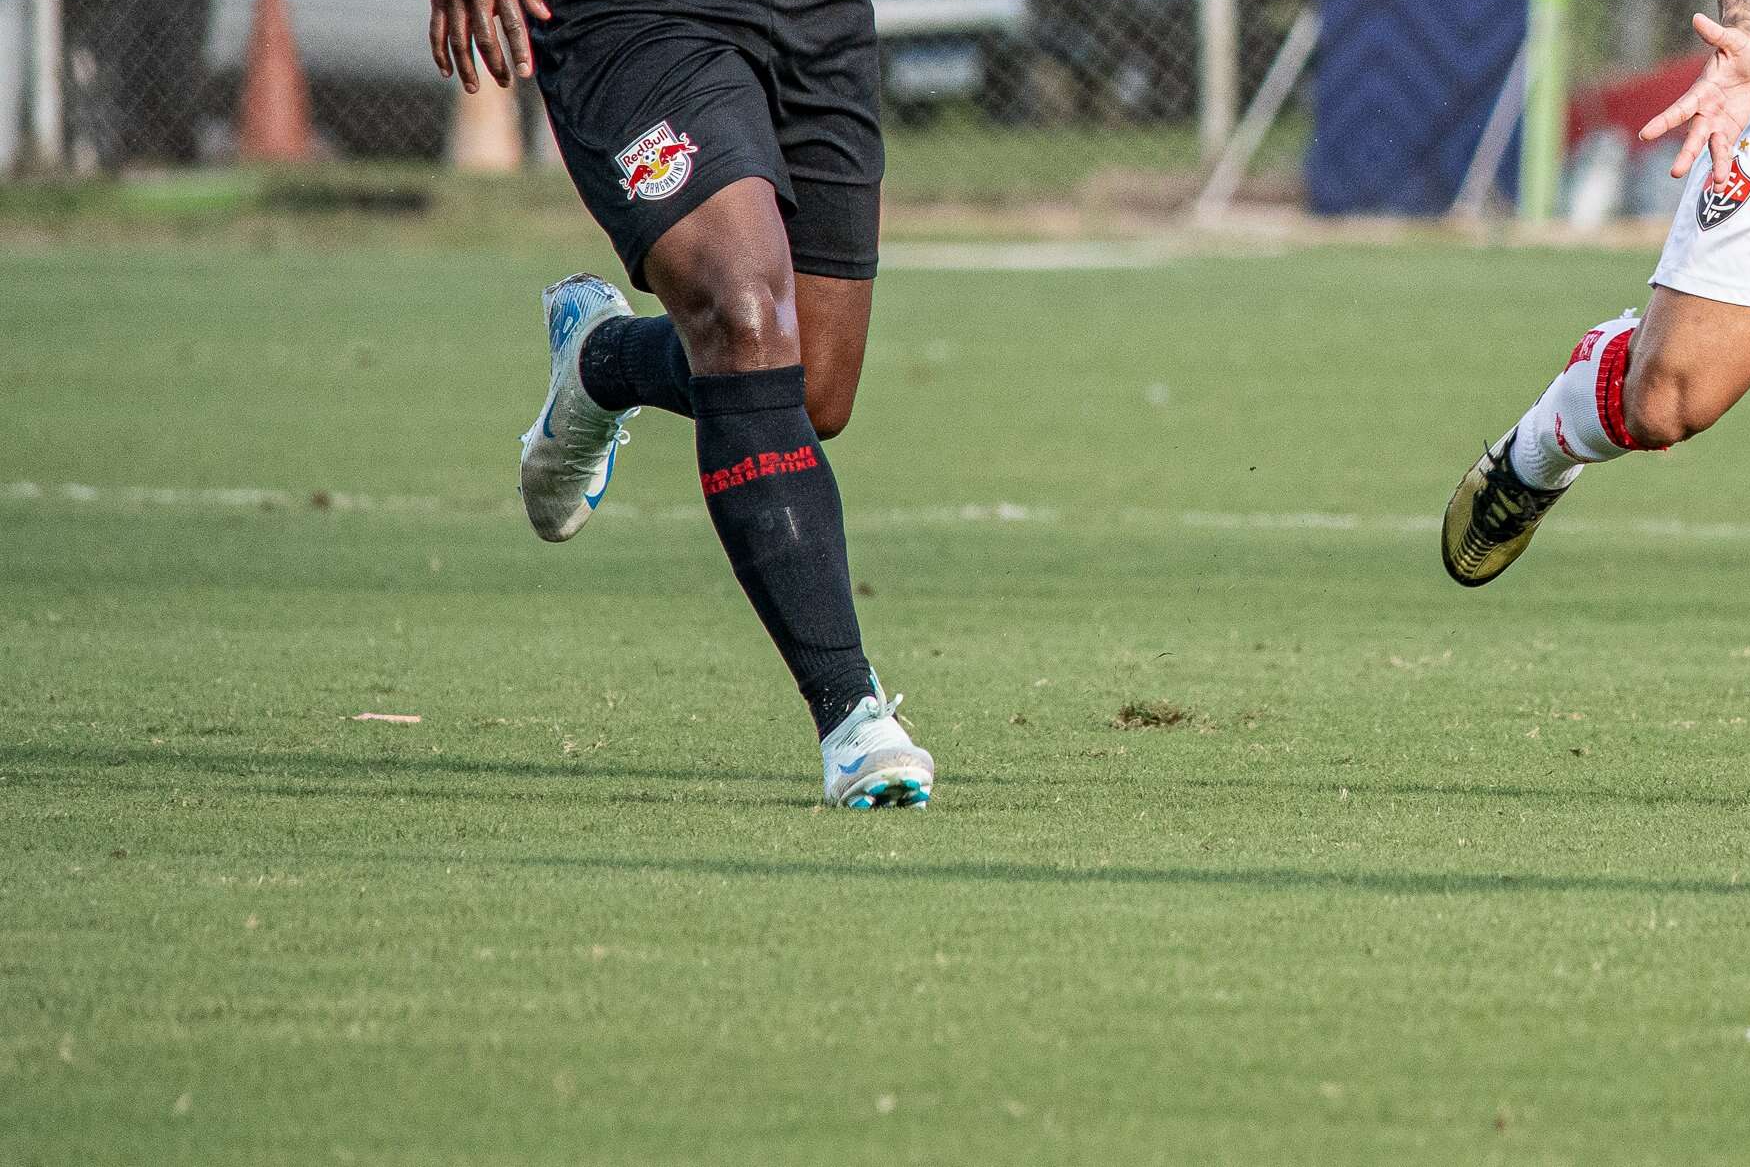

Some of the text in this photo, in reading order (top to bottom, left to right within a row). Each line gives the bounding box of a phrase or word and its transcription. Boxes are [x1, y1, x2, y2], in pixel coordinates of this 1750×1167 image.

[622, 129, 669, 167] Red Bull
[644, 161, 686, 194] BRAGANTINO
